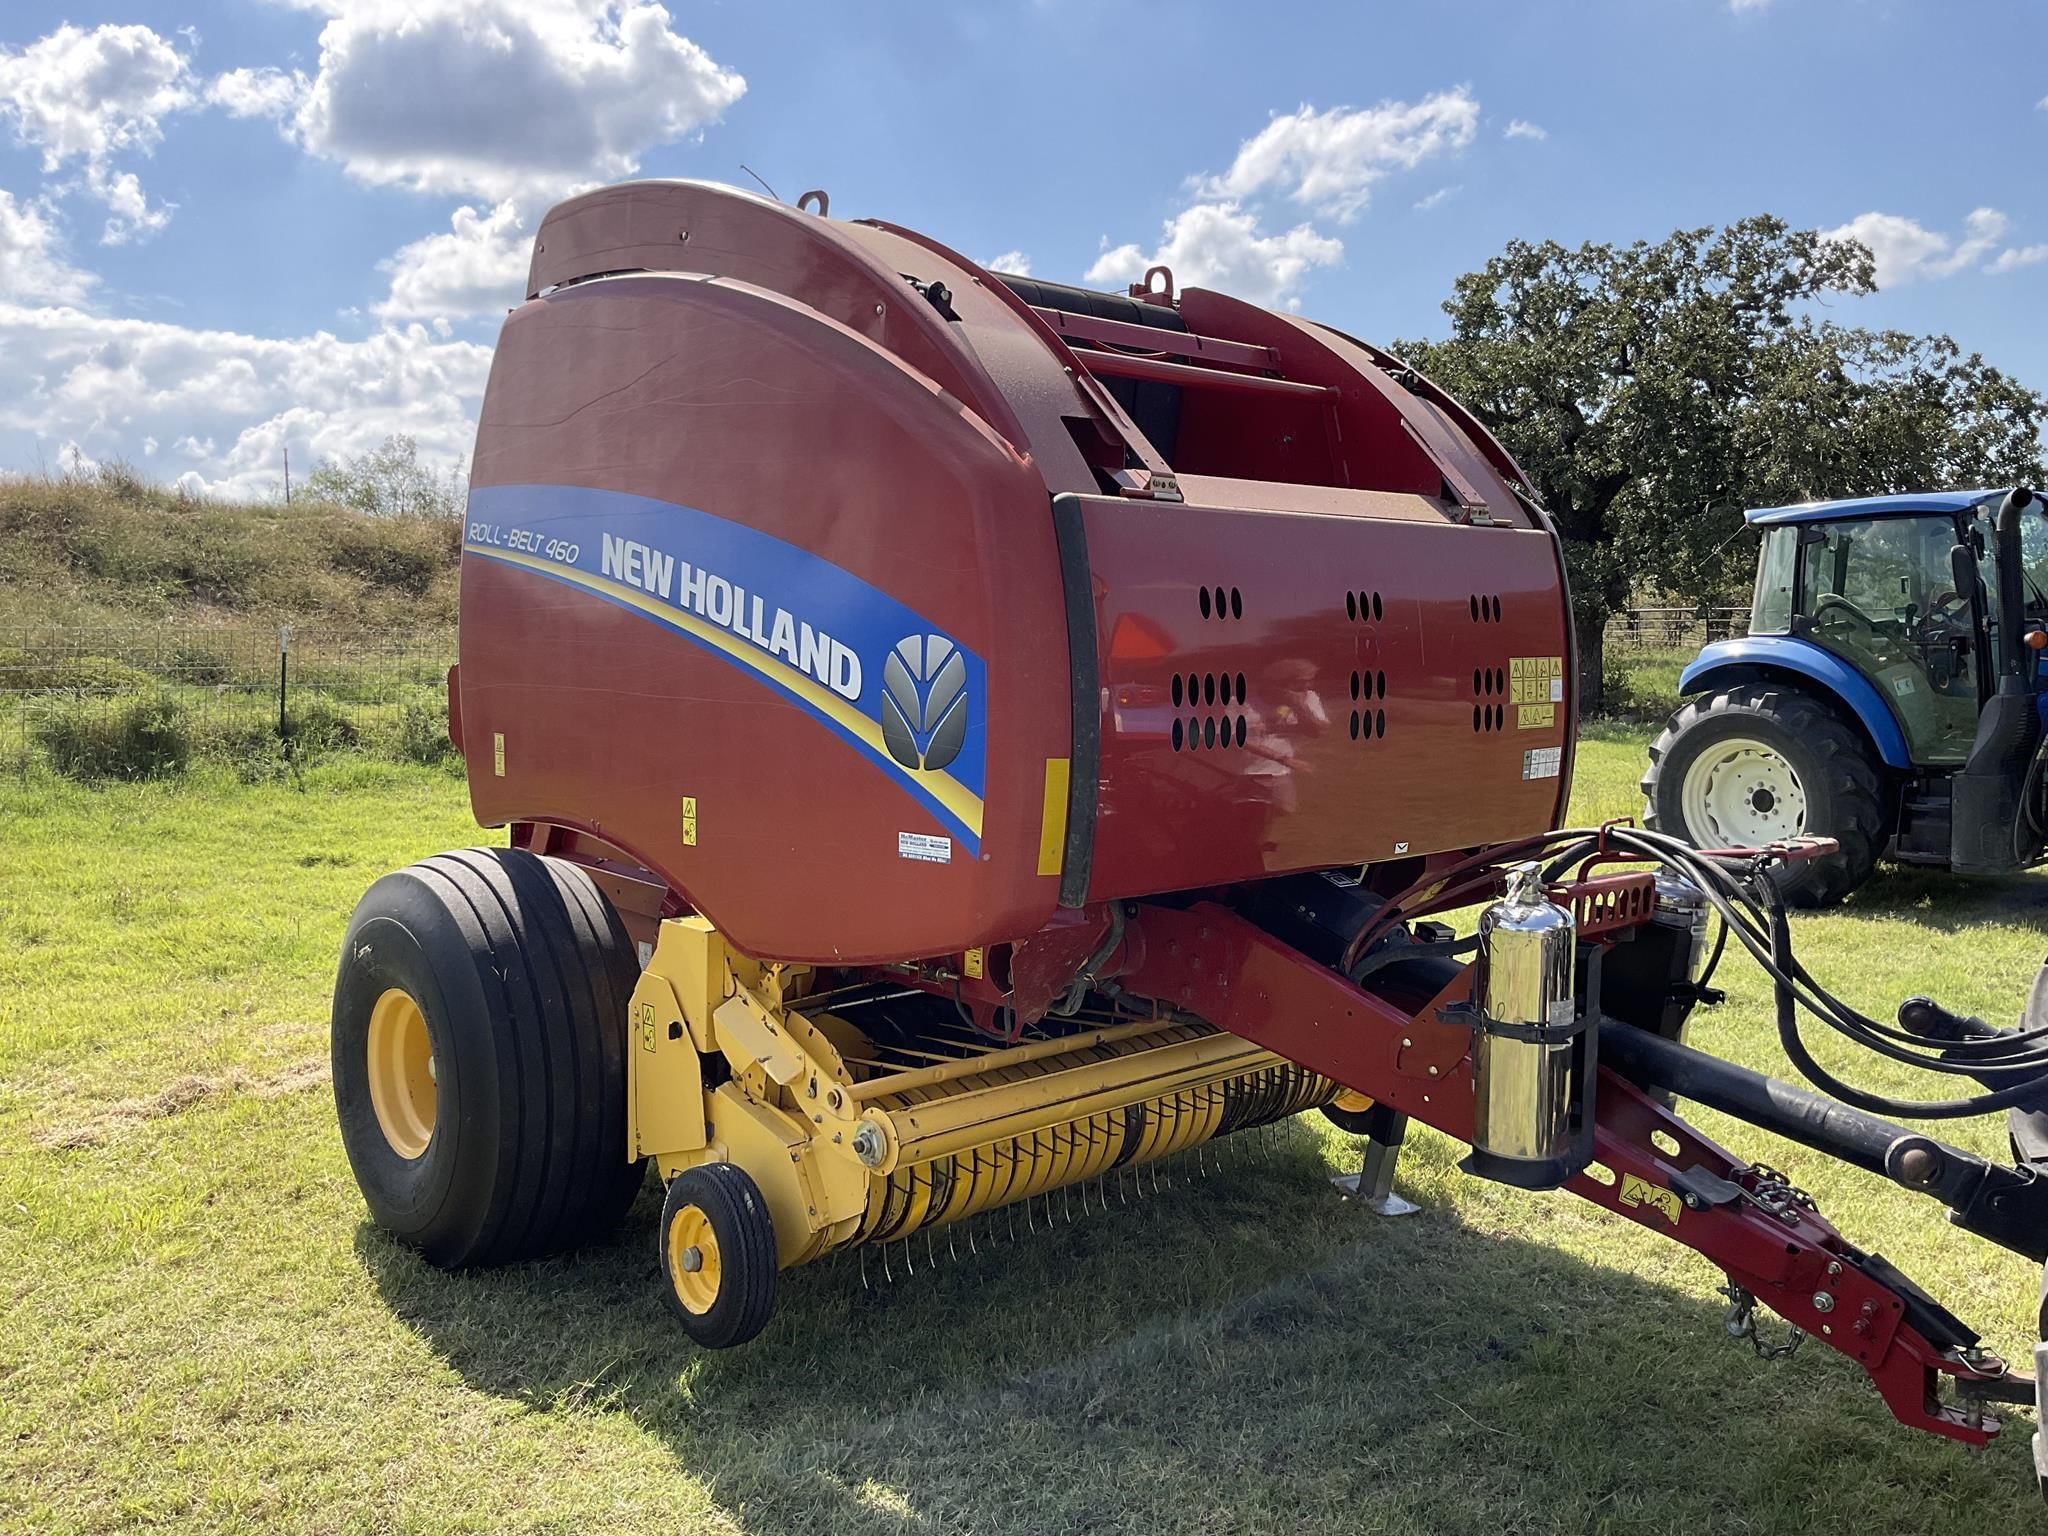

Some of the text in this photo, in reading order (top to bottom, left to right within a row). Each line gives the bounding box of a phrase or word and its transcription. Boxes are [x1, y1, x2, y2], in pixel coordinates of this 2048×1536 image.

[468, 522, 580, 564] ROLL-BELT 460
[601, 532, 863, 701] NEW HOLLAND
